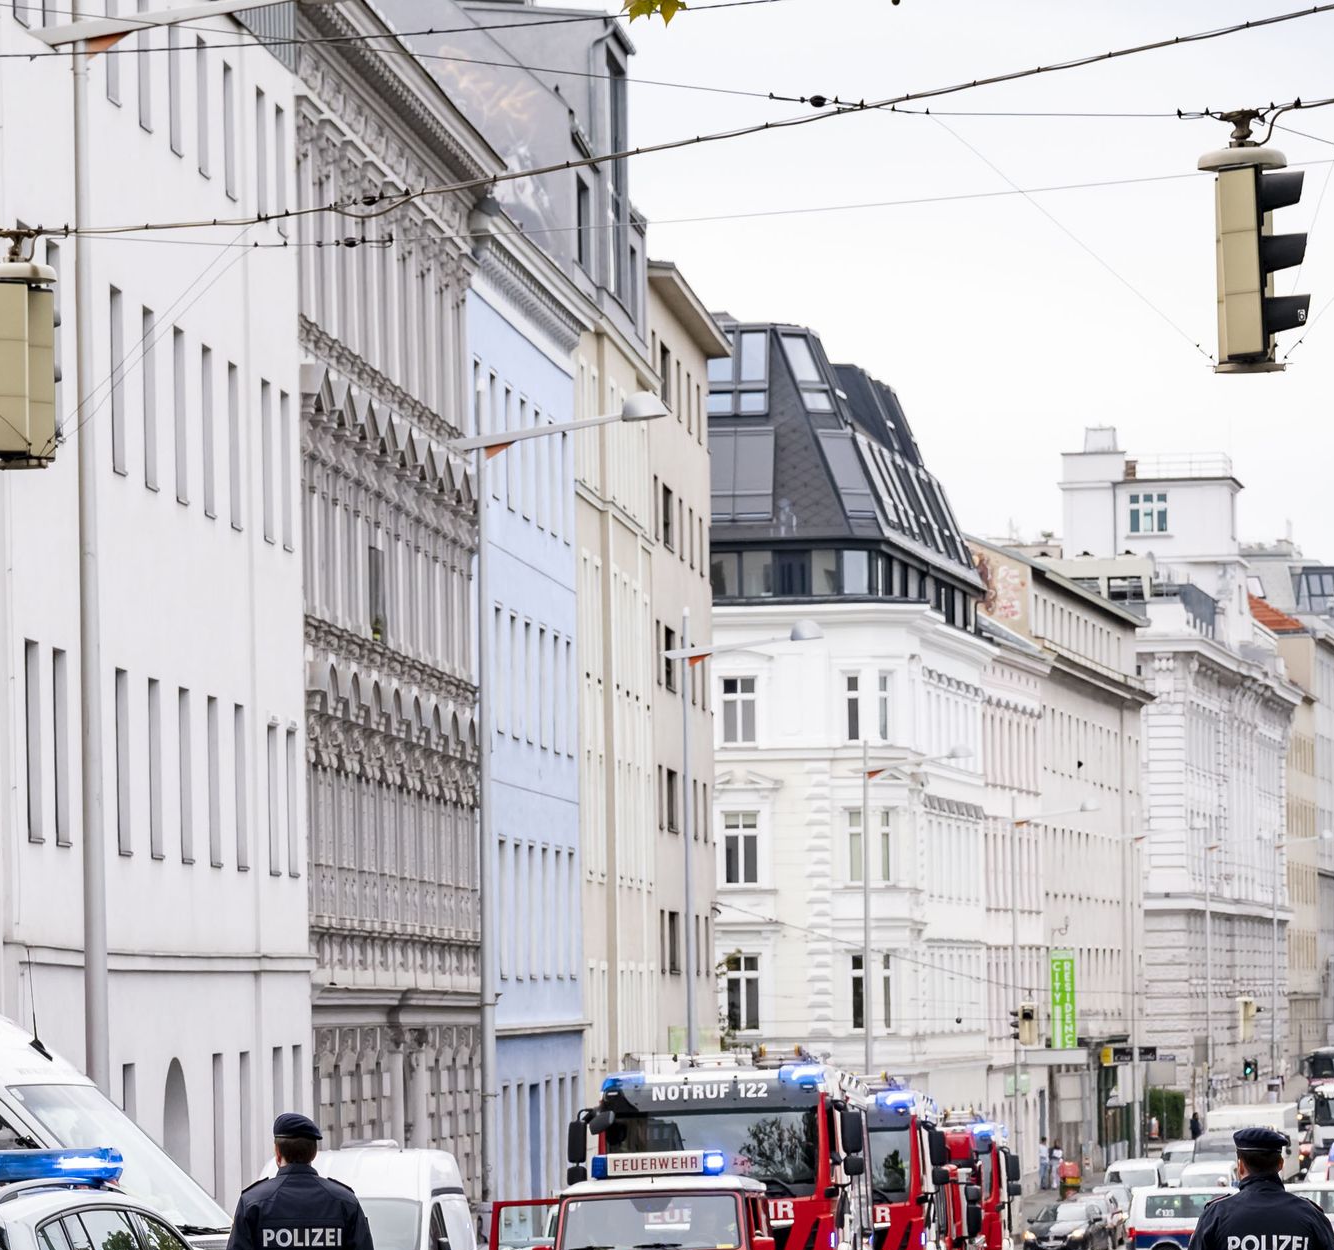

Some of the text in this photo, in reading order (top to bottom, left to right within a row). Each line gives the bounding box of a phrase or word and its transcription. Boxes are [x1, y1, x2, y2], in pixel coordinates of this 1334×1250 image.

[1052, 961, 1062, 1004] CITY
[652, 1082, 768, 1101] NOTRUF 122
[613, 1156, 698, 1172] FEUERWEHR
[262, 1228, 342, 1247] POLIZEI
